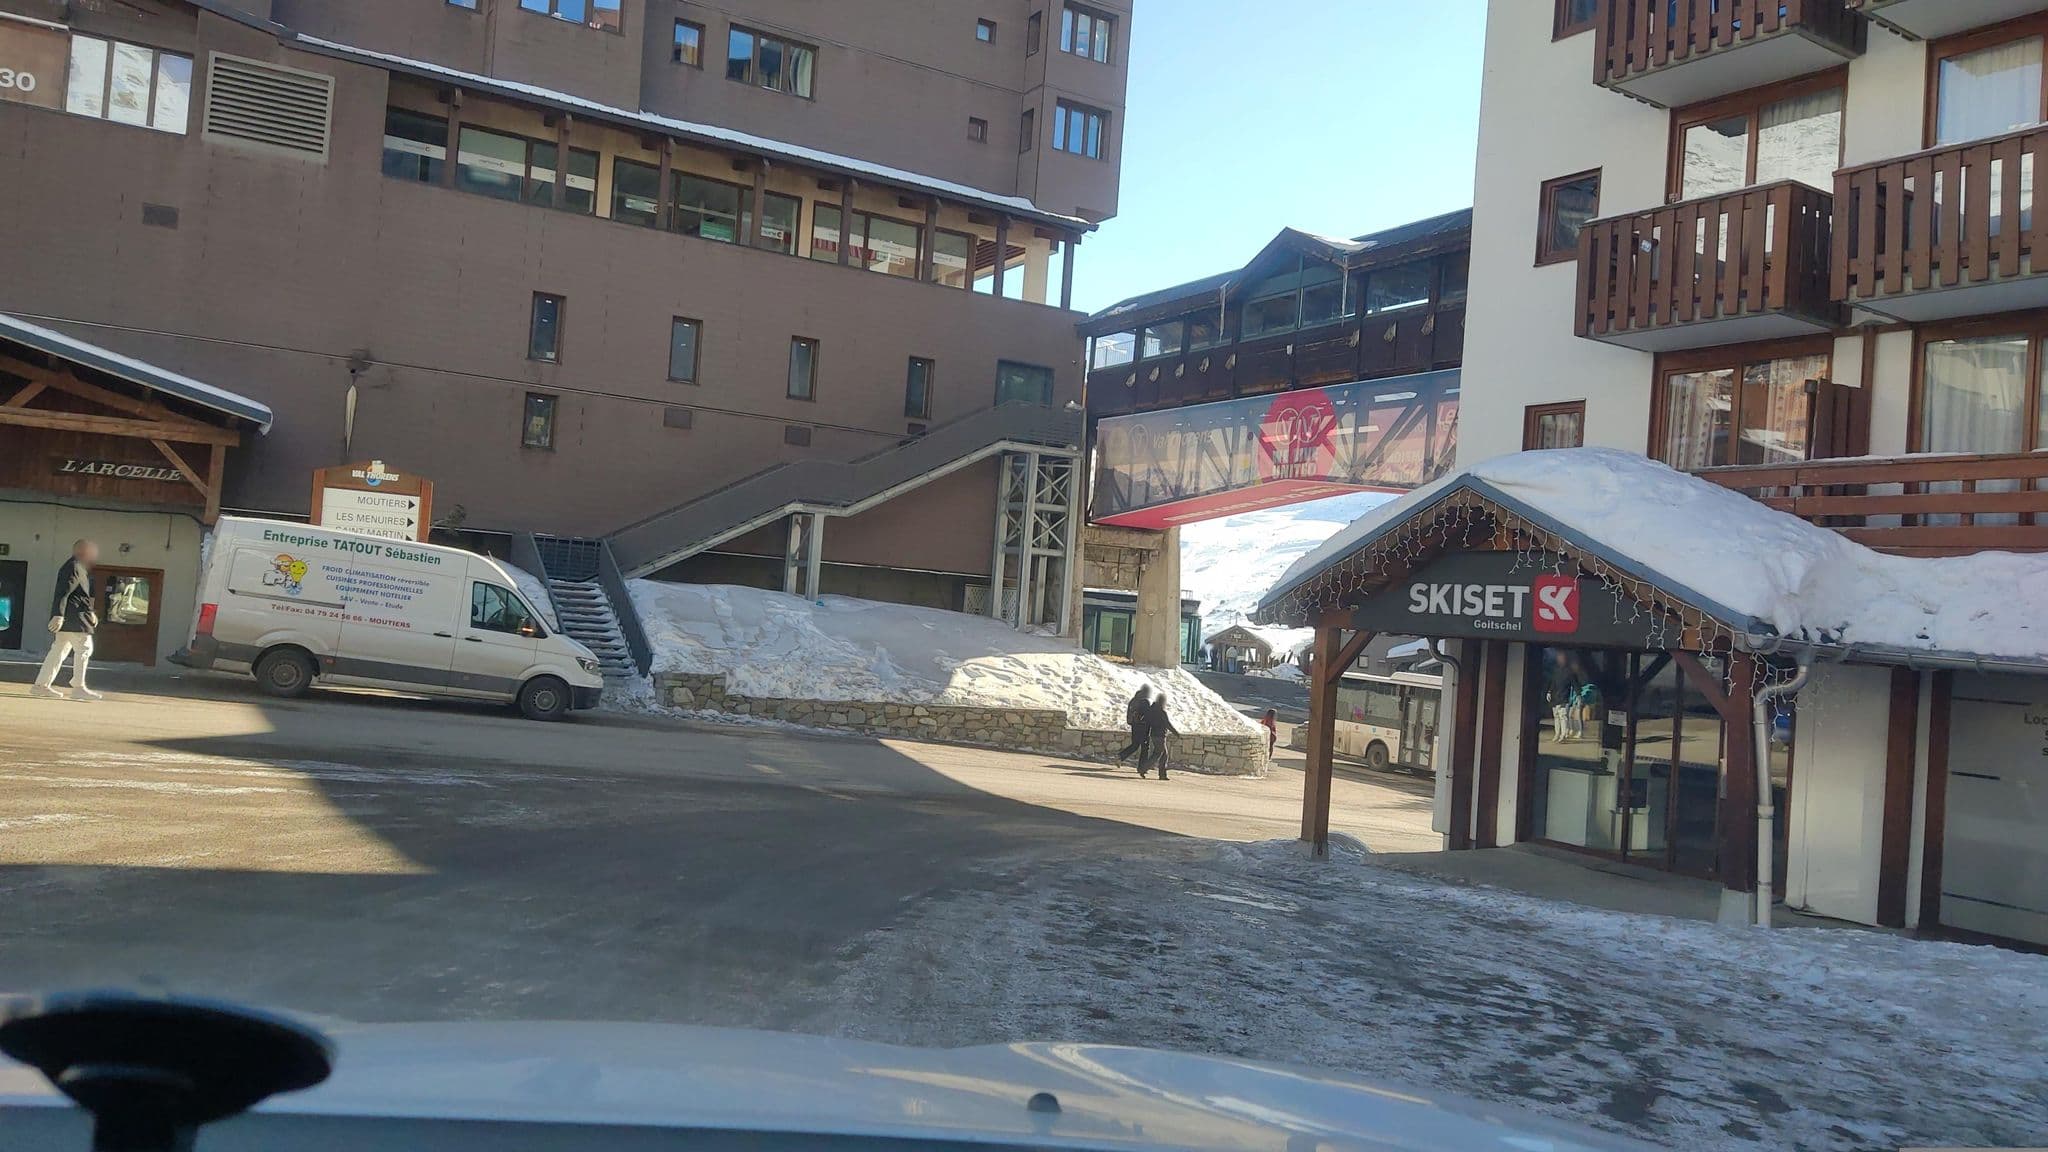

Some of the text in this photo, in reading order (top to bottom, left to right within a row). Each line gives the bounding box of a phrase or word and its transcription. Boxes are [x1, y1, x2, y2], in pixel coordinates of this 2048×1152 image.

[61, 460, 181, 481] L'ARCELLE
[357, 496, 407, 508] MOUTIERS
[336, 512, 405, 526] LES MENUIRES
[366, 529, 404, 539] MARTIN
[264, 529, 441, 565] Entreprise TATOUT Sébastien
[322, 565, 343, 574] FROID
[345, 568, 396, 582] CLIMATISATION
[326, 574, 424, 595] CUISINES PROFESSIONNELLES
[1408, 582, 1530, 618] SKISET
[369, 617, 411, 629] MOUTIERS
[1473, 619, 1522, 631] Goitschel
